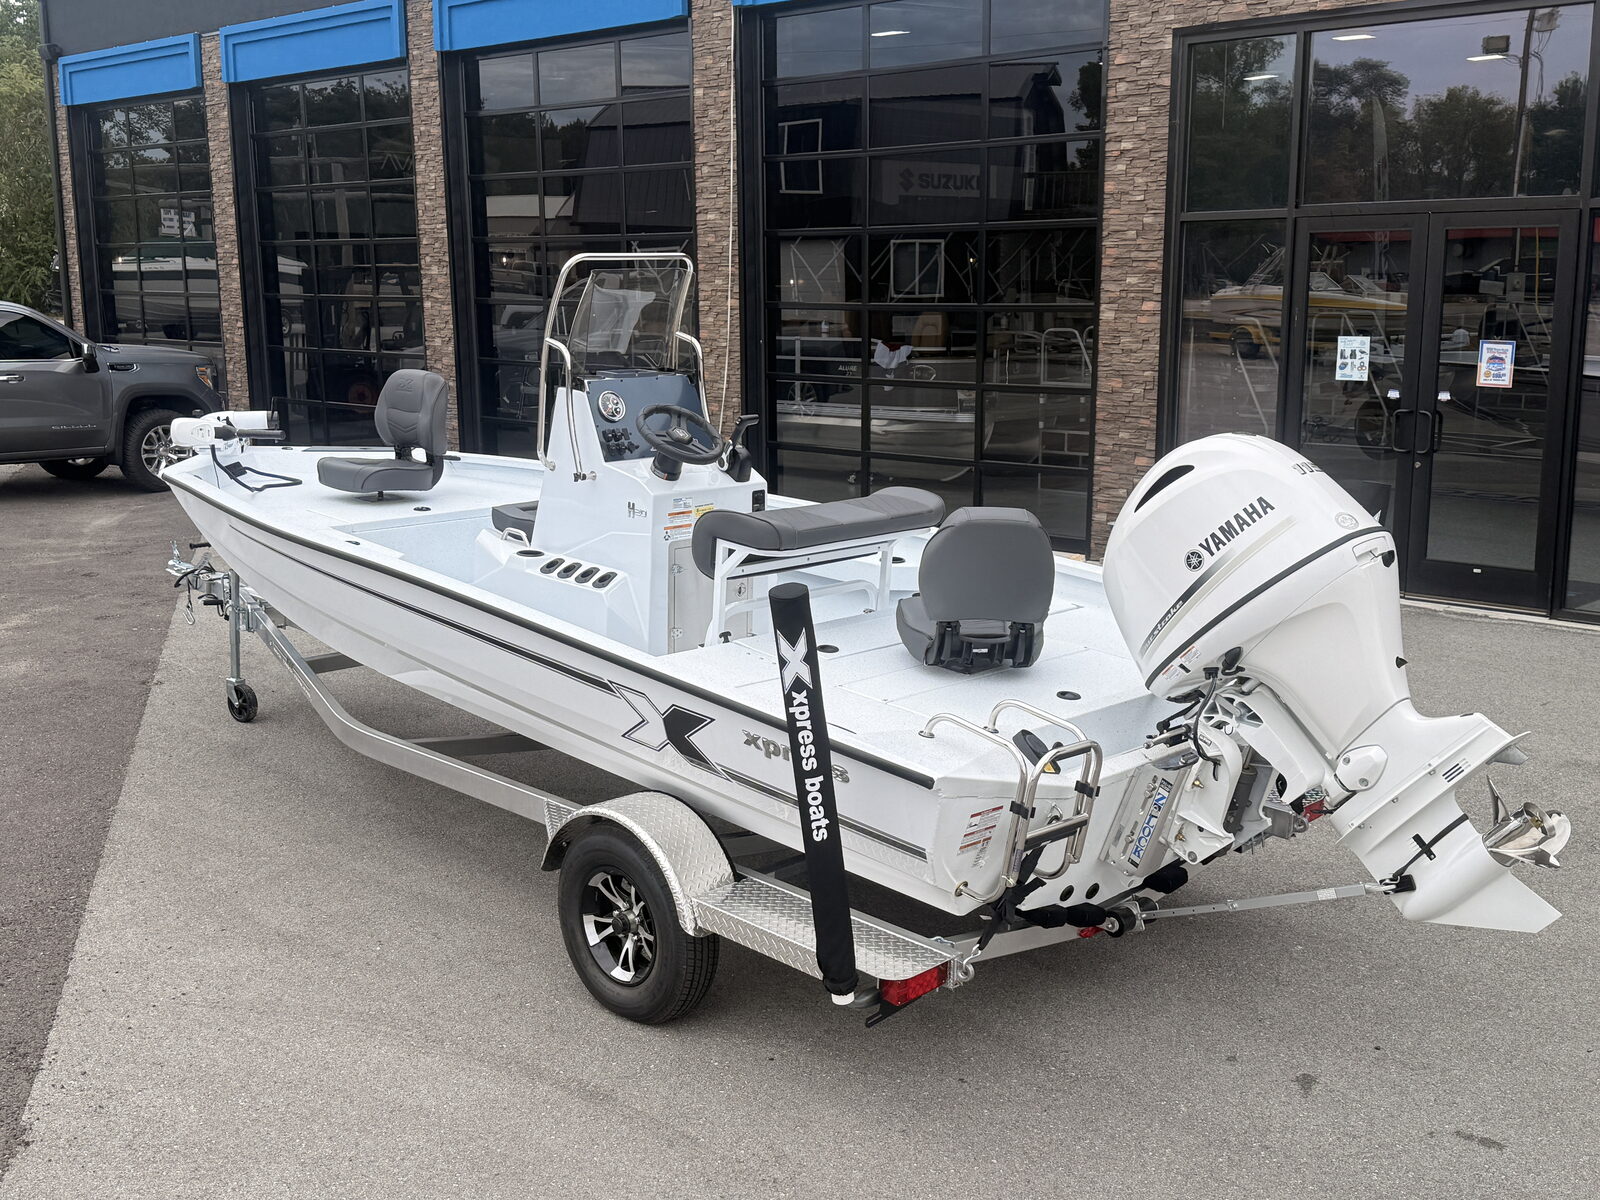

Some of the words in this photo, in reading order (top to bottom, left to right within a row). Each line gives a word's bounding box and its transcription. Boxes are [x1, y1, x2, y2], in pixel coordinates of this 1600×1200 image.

[918, 173, 980, 190] SUZUKI
[1198, 496, 1276, 557] YAMAHA
[741, 729, 850, 784] xprs
[788, 689, 818, 772] xpress
[804, 775, 830, 842] boats
